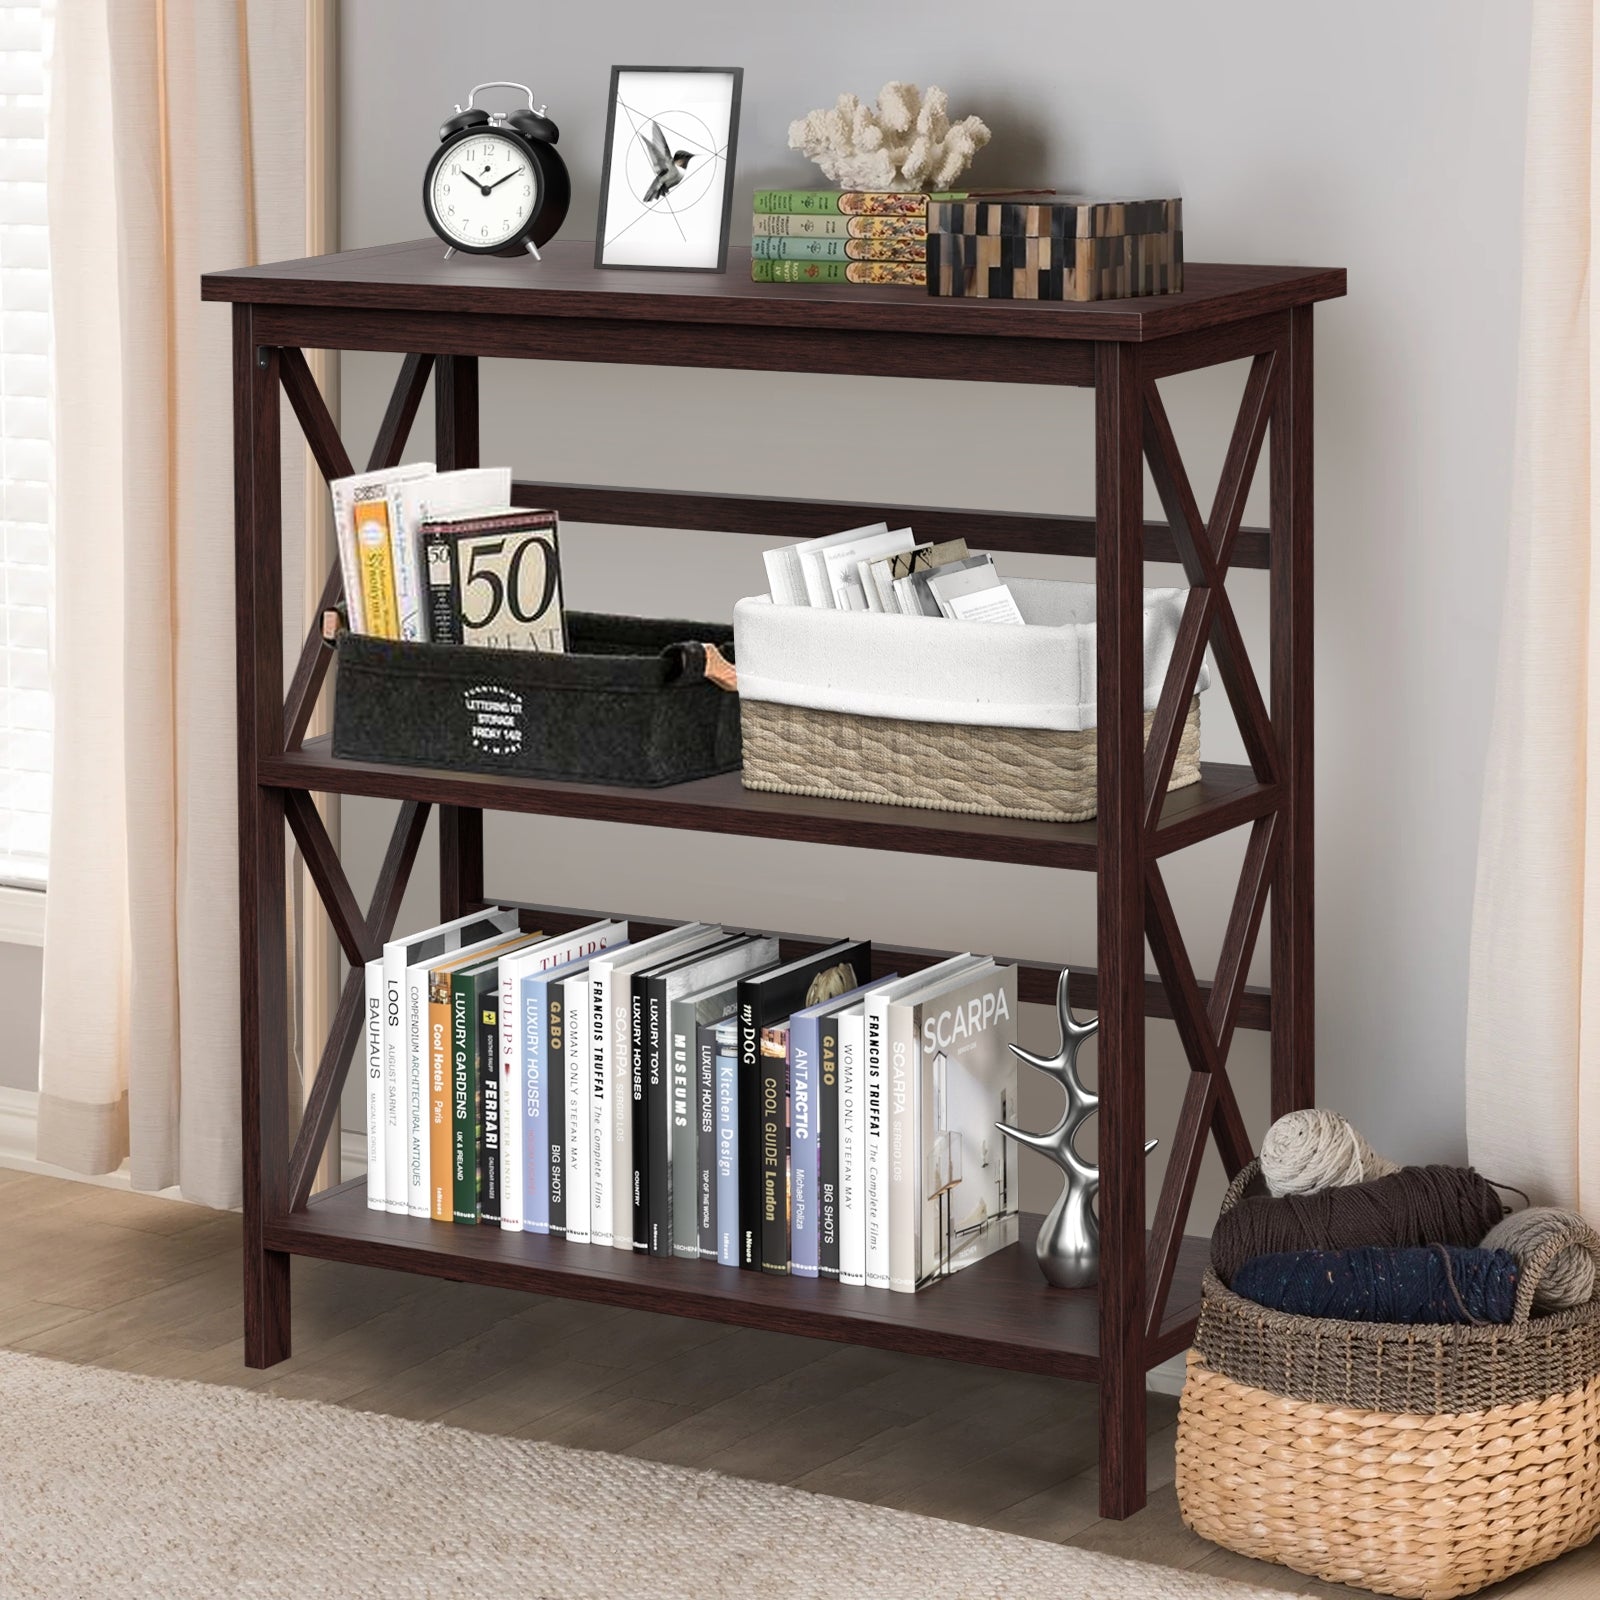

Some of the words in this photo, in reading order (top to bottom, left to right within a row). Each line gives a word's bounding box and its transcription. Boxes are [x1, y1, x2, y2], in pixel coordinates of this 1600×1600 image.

[467, 150, 475, 161] 11
[484, 144, 495, 156] 12
[507, 150, 511, 161] 1
[451, 164, 461, 176] 10
[518, 165, 526, 176] 2
[443, 184, 451, 196] 9
[523, 185, 531, 197] 3
[447, 205, 455, 217] 8
[462, 219, 470, 231] 7
[502, 220, 510, 231] 5
[516, 206, 523, 218] 4
[481, 225, 488, 237] 6
[775, 266, 782, 276] AT
[428, 547, 450, 565] 50
[460, 536, 558, 629] 50
[387, 980, 399, 1027] LOOS
[410, 986, 419, 1053] COMPENDIUM
[455, 992, 466, 1048] LUXURY
[502, 978, 513, 1055] TULIPS
[593, 981, 603, 1041] FRANCOIS
[632, 995, 642, 1046] LUXURY
[650, 998, 658, 1048] LUXURY
[740, 1004, 752, 1026] my
[923, 987, 1010, 1054] SCARPA
[369, 997, 381, 1079] BAUHAUS
[433, 1023, 444, 1051] Cool
[526, 997, 539, 1055] LUXURY
[550, 1001, 562, 1050] GABO
[569, 1009, 578, 1058] WOMAN
[615, 1006, 627, 1078] SCARPA
[388, 1043, 396, 1082] AUGUST
[743, 1027, 756, 1064] DOG
[823, 1035, 835, 1086] GABO
[869, 1015, 880, 1077] FRANCOIS
[433, 1053, 445, 1092] Hotels
[456, 1052, 467, 1119] GARDENS
[570, 1062, 579, 1095] ONLY
[593, 1047, 604, 1100] TRUFFAT
[633, 1048, 642, 1101] HOUSES
[650, 1051, 659, 1085] TOYS
[674, 1033, 687, 1127] MUSEUMS
[701, 1045, 711, 1087] LUXURY
[844, 1044, 853, 1094] WOMAN
[892, 1041, 906, 1115] SCARPA
[388, 1084, 397, 1126] SARNITZ
[411, 1055, 420, 1134] ARCHITECTURAL
[504, 1090, 511, 1104] BY
[527, 1058, 540, 1118] HOUSES
[616, 1083, 624, 1119] SERGIO
[720, 1067, 733, 1122] Kitchen
[764, 1077, 777, 1118] COOL
[794, 1047, 809, 1140] ANTARCTIC
[434, 1100, 444, 1124] Paris
[485, 1079, 498, 1149] FERRARI
[570, 1099, 578, 1143] STEFAN
[702, 1088, 712, 1133] HOUSES
[844, 1098, 853, 1133] ONLY
[869, 1083, 880, 1137] TRUFFAT
[456, 1131, 463, 1142] UK
[616, 1121, 624, 1142] LOS
[764, 1122, 778, 1167] GUIDE
[893, 1119, 902, 1158] SERGIO
[412, 1137, 421, 1187] ANTIQUES
[456, 1149, 464, 1181] IRELAND
[551, 1144, 561, 1163] BIG
[570, 1147, 578, 1170] MAY
[593, 1128, 602, 1178] Complete
[719, 1128, 734, 1176] Design
[844, 1137, 852, 1181] STEFAN
[870, 1143, 878, 1163] The
[893, 1160, 903, 1182] LOS
[552, 1165, 561, 1203] SHOTS
[594, 1181, 603, 1209] Films
[703, 1183, 709, 1192] OF
[765, 1171, 777, 1221] London
[795, 1168, 805, 1201] Michael
[823, 1183, 834, 1202] BIG
[844, 1186, 852, 1210] MAY
[868, 1167, 878, 1218] Complete
[795, 1202, 805, 1230] Poliza
[824, 1205, 834, 1244] SHOTS
[870, 1221, 879, 1250] Films
